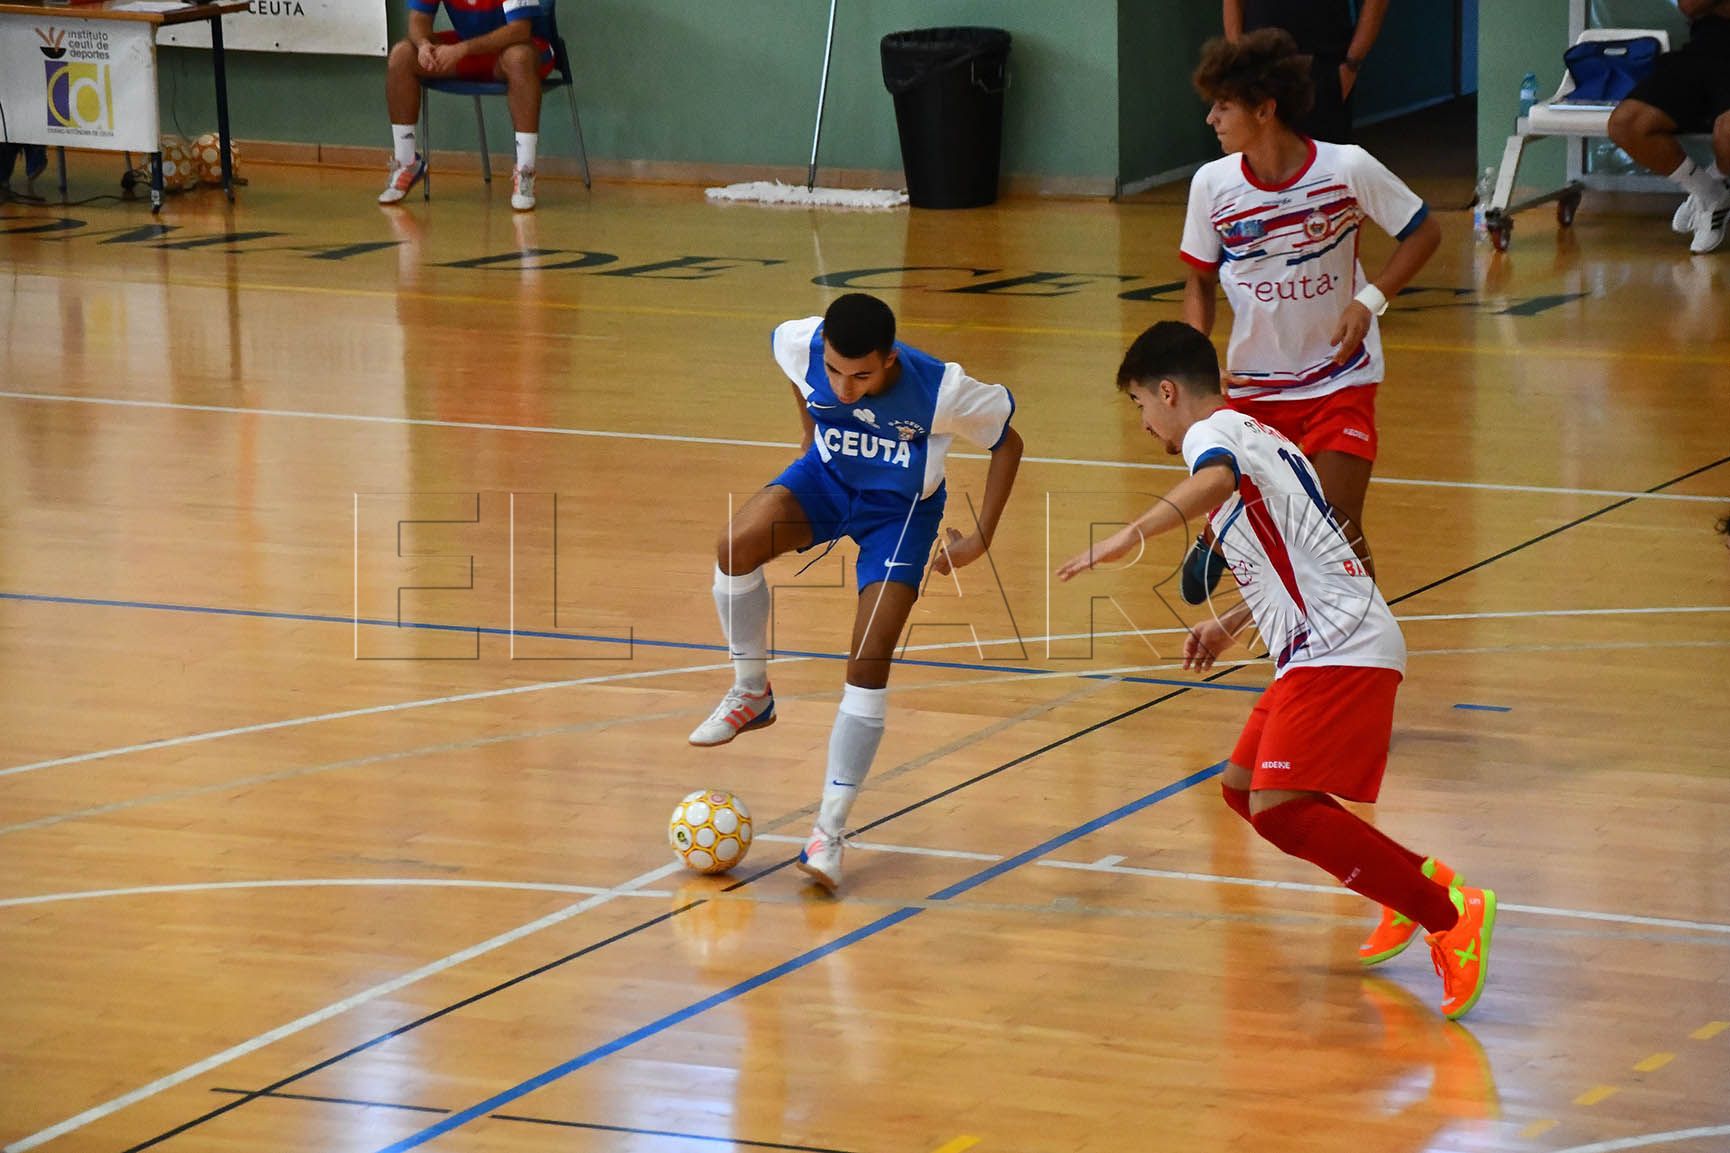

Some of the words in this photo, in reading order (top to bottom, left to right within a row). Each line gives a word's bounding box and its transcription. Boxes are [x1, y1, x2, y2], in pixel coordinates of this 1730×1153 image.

[248, 0, 305, 16] CEUTA
[68, 30, 109, 41] instituto
[70, 50, 110, 60] deportes
[824, 427, 911, 468] CEUTA
